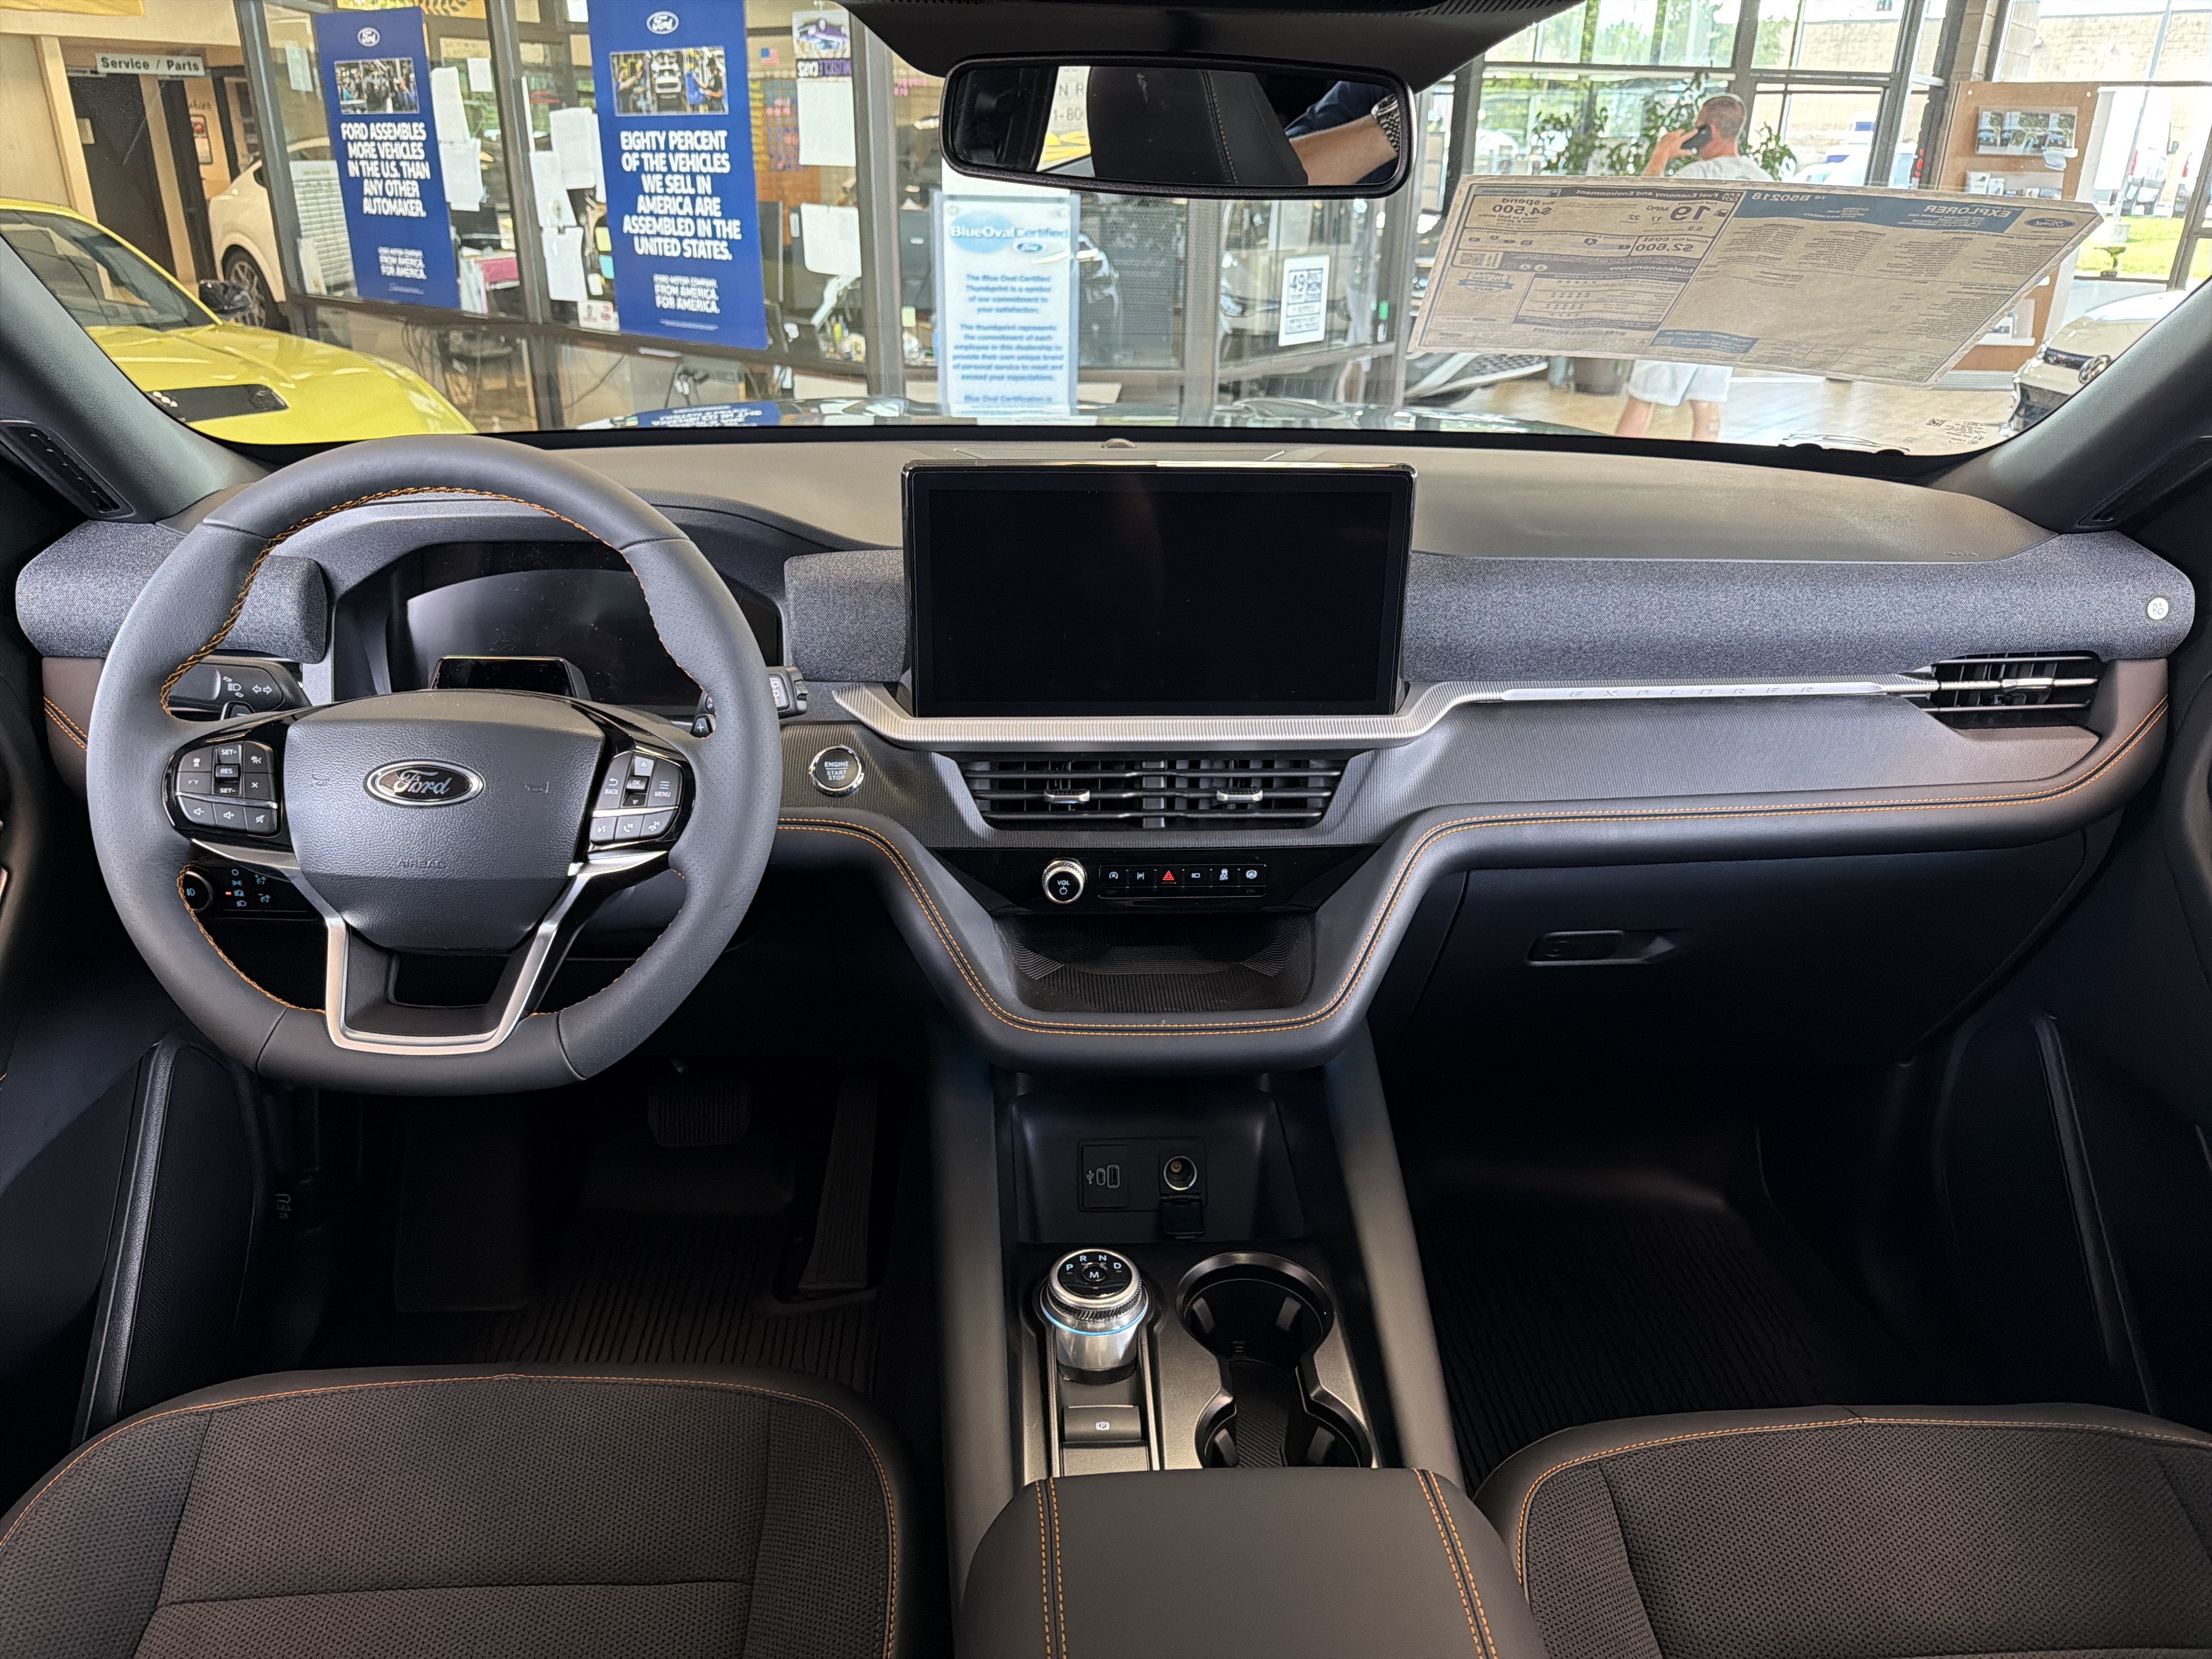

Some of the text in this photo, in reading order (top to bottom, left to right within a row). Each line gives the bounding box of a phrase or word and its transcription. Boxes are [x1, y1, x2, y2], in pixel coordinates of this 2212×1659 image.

[651, 15, 673, 31] Ford
[101, 57, 149, 70] Service
[166, 59, 200, 72] Parts
[340, 122, 426, 140] FORD ASSEMBLES
[620, 130, 727, 150] EIGHTY PERCENT
[347, 142, 425, 160] MORE VEHICLES
[347, 160, 360, 177] IN
[359, 160, 381, 178] THE
[380, 160, 400, 178] U.S.
[399, 161, 431, 179] THAN
[622, 152, 730, 173] OF THE VEHICLES
[363, 179, 420, 198] ANY OTHER
[641, 173, 712, 194] WE SELL IN
[363, 197, 426, 217] AUTOMAKER.
[637, 195, 721, 217] AMERICA ARE
[623, 214, 742, 239] ASSEMBLED IN THE
[634, 235, 732, 261] UNITED STATES.
[1569, 686, 1813, 698] EXPLORER
[393, 769, 453, 795] Ford
[397, 860, 447, 869] AIRBAG
